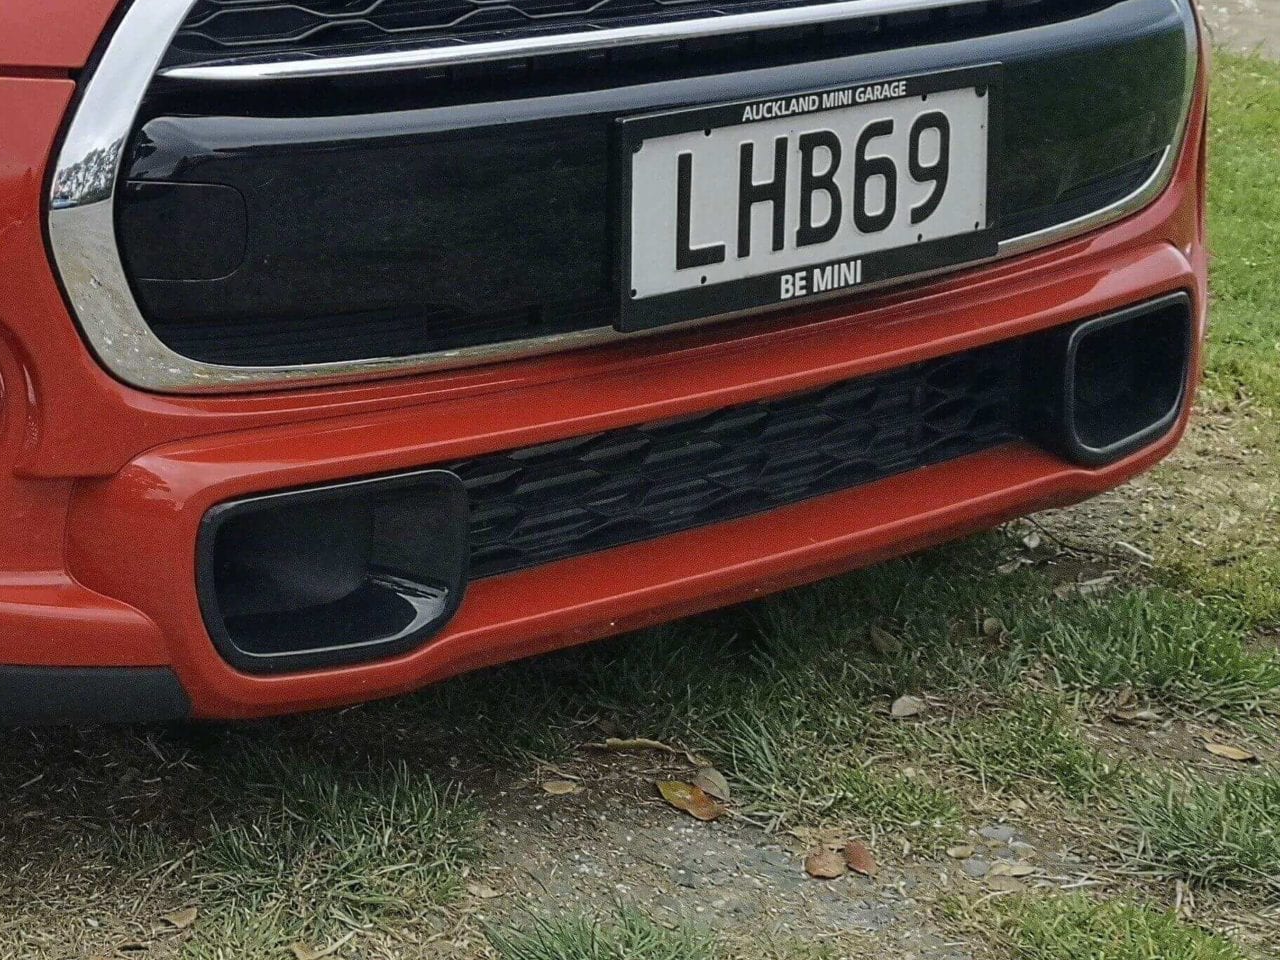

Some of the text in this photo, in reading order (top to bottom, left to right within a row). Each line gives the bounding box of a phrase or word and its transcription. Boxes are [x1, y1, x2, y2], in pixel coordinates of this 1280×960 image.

[742, 80, 907, 122] AUCKLAND MINI GARAGE
[675, 110, 950, 271] LHB69
[780, 260, 862, 300] BE MINI
